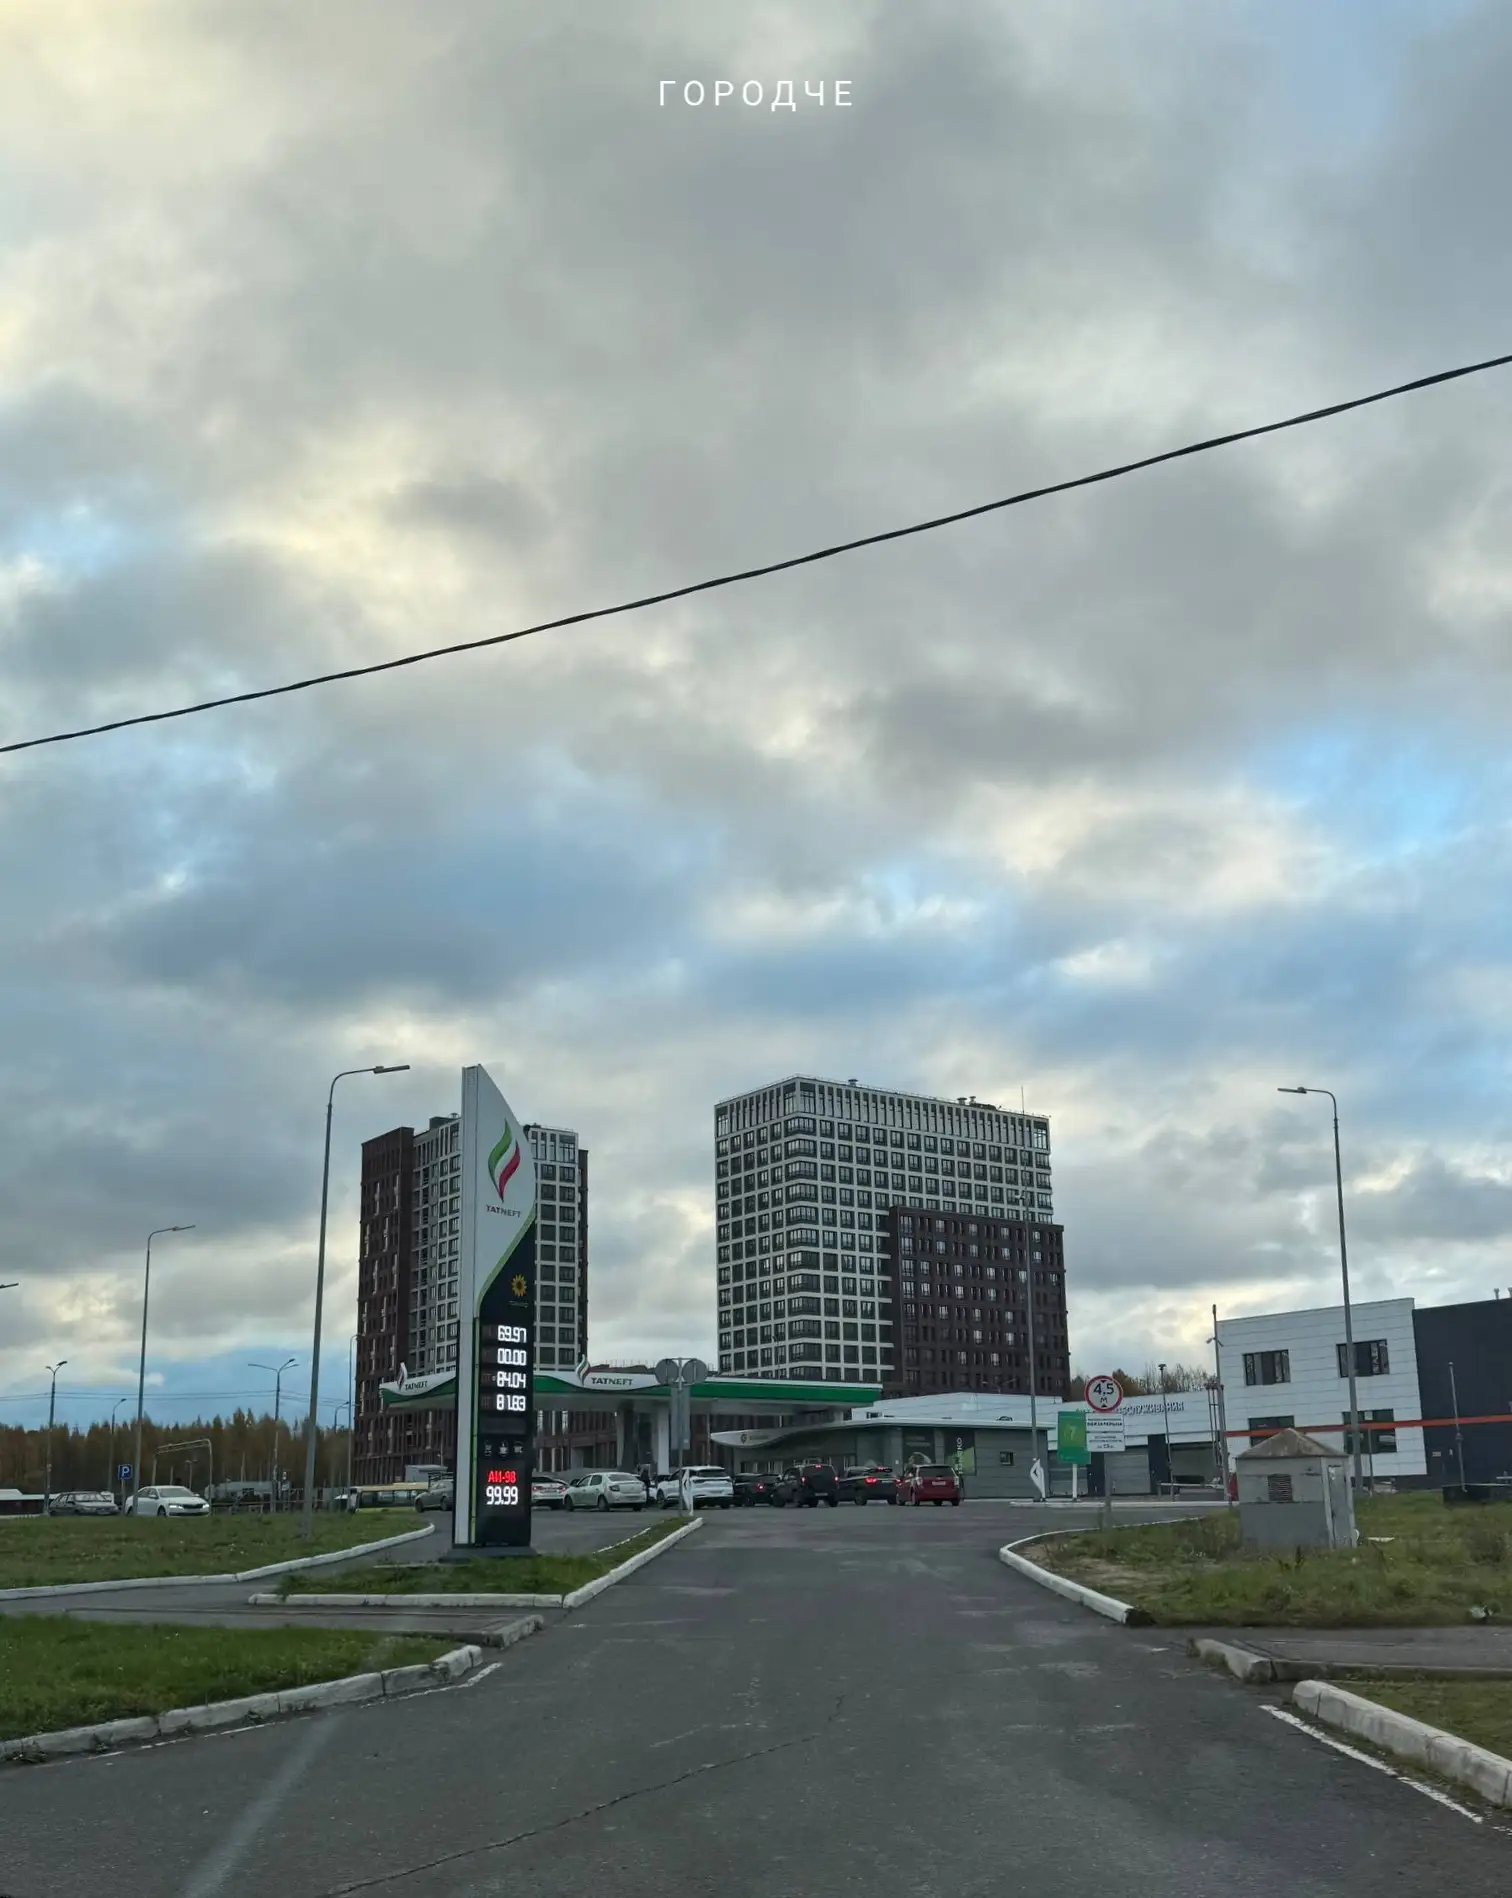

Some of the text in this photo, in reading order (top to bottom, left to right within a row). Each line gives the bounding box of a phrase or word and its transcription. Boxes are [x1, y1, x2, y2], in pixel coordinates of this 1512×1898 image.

[485, 1204, 522, 1218] TATNEFT
[497, 1325, 527, 1343] 69.97
[497, 1348, 527, 1366] 00.00
[404, 1380, 428, 1391] TATNEFT
[496, 1371, 527, 1388] 84.04
[591, 1377, 634, 1386] TATNEFT
[496, 1394, 526, 1411] 81.83
[121, 1466, 130, 1477] P
[486, 1486, 519, 1505] 99.99
